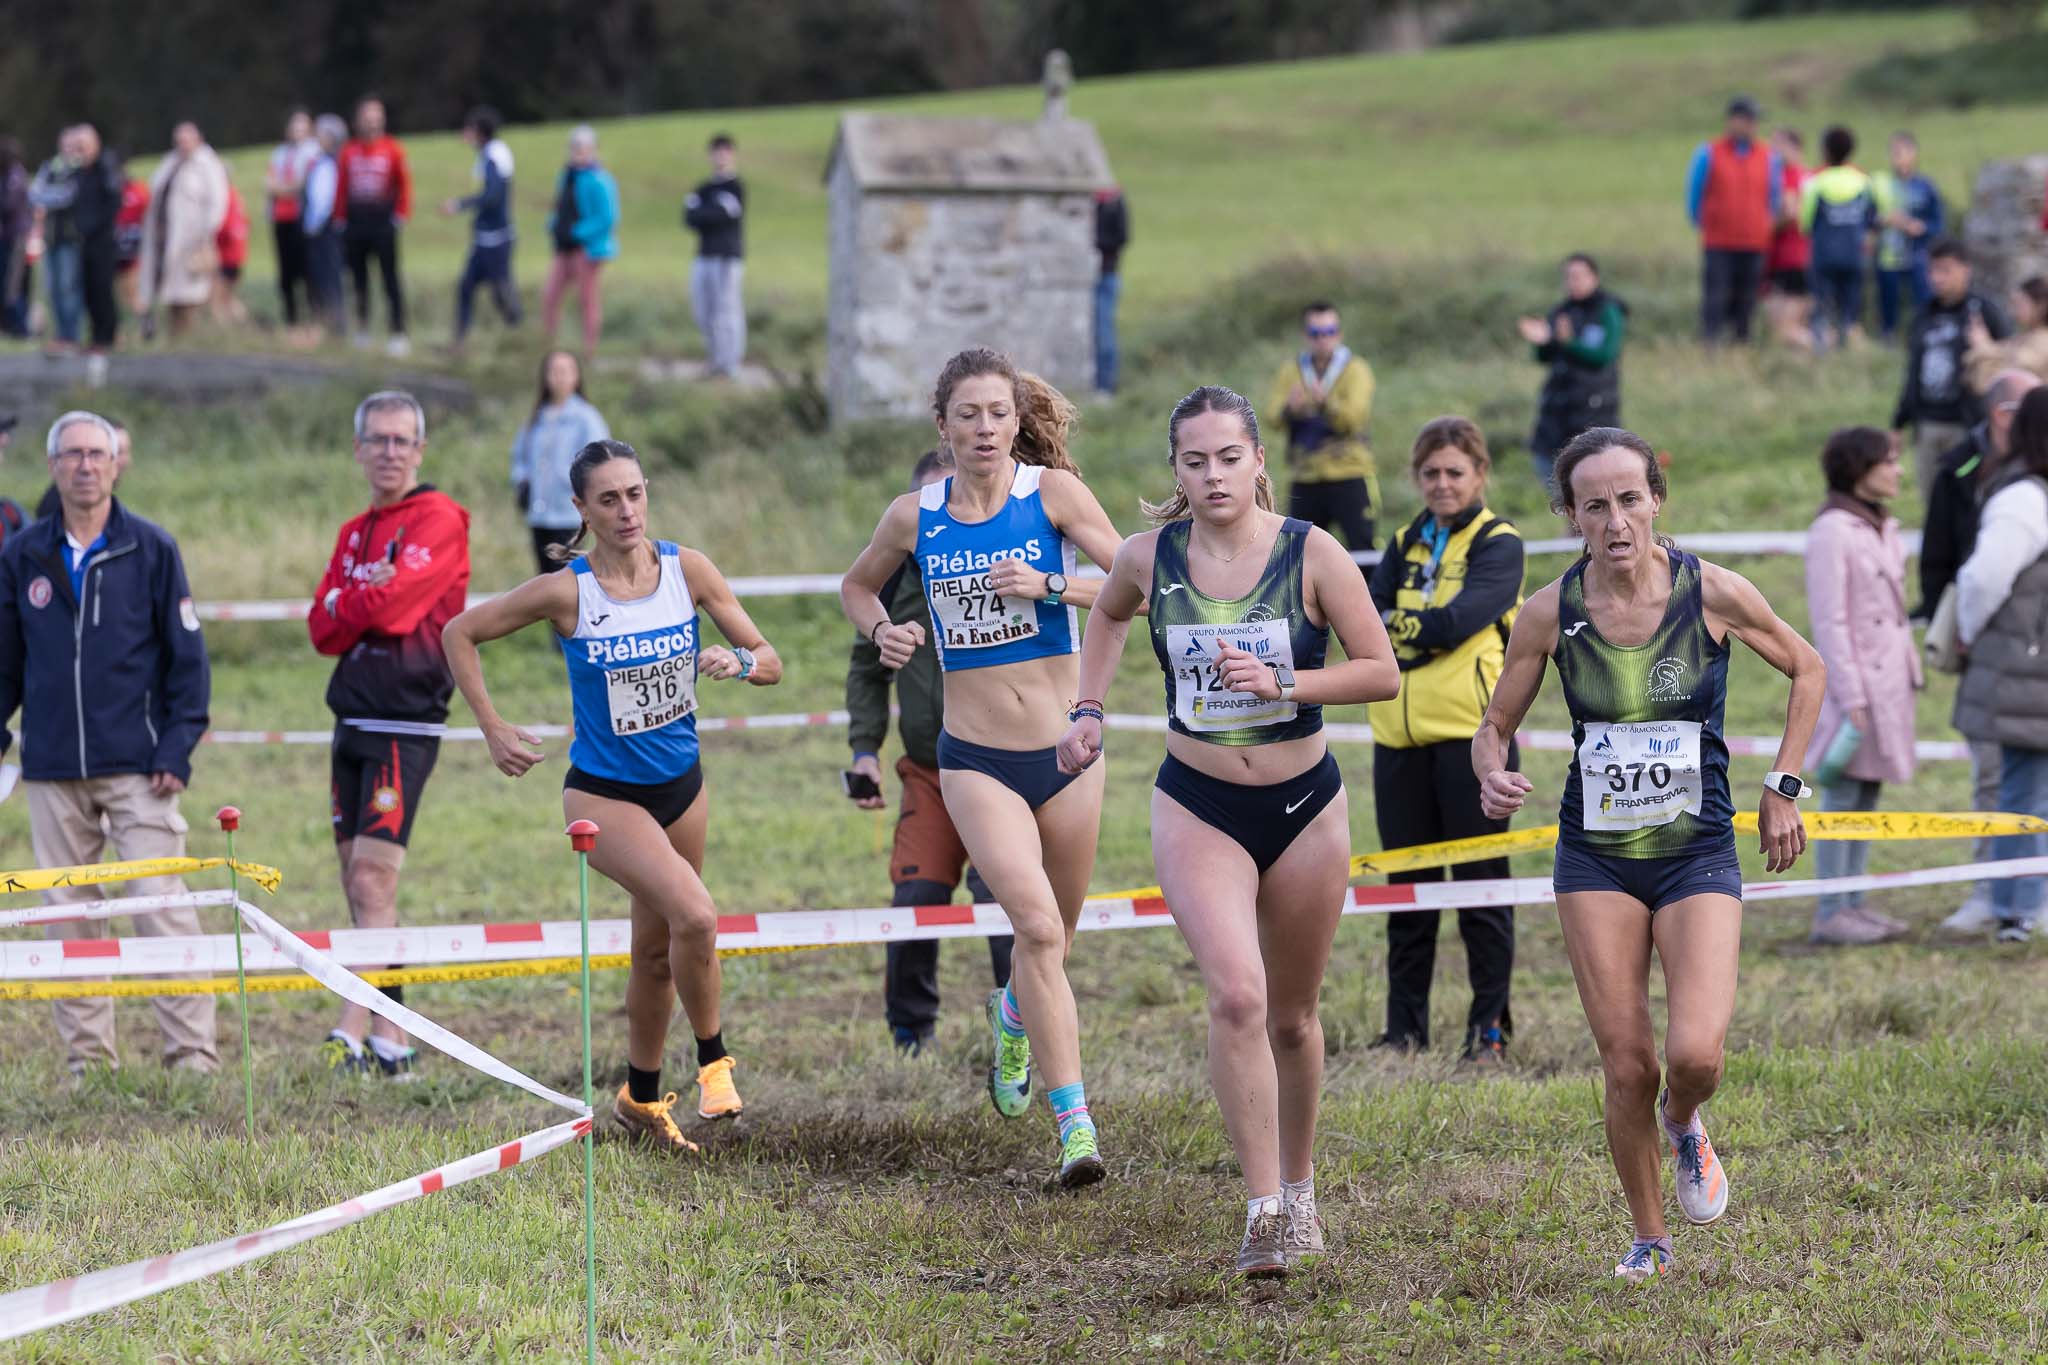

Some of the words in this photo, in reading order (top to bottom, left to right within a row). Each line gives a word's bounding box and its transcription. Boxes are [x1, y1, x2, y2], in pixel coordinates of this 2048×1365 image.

[932, 575, 995, 599] PIELAG
[958, 592, 1006, 621] 274
[946, 628, 965, 646] La
[968, 622, 1034, 645] Encina
[1188, 629, 1215, 637] GRUPO
[610, 651, 693, 687] PIELAGOS
[634, 674, 677, 708] 316
[1651, 694, 1692, 702] ATLETISMO
[615, 718, 638, 734] La
[642, 699, 693, 729] Encina
[1604, 762, 1672, 793] 370
[1614, 787, 1687, 809] FRANFERMA
